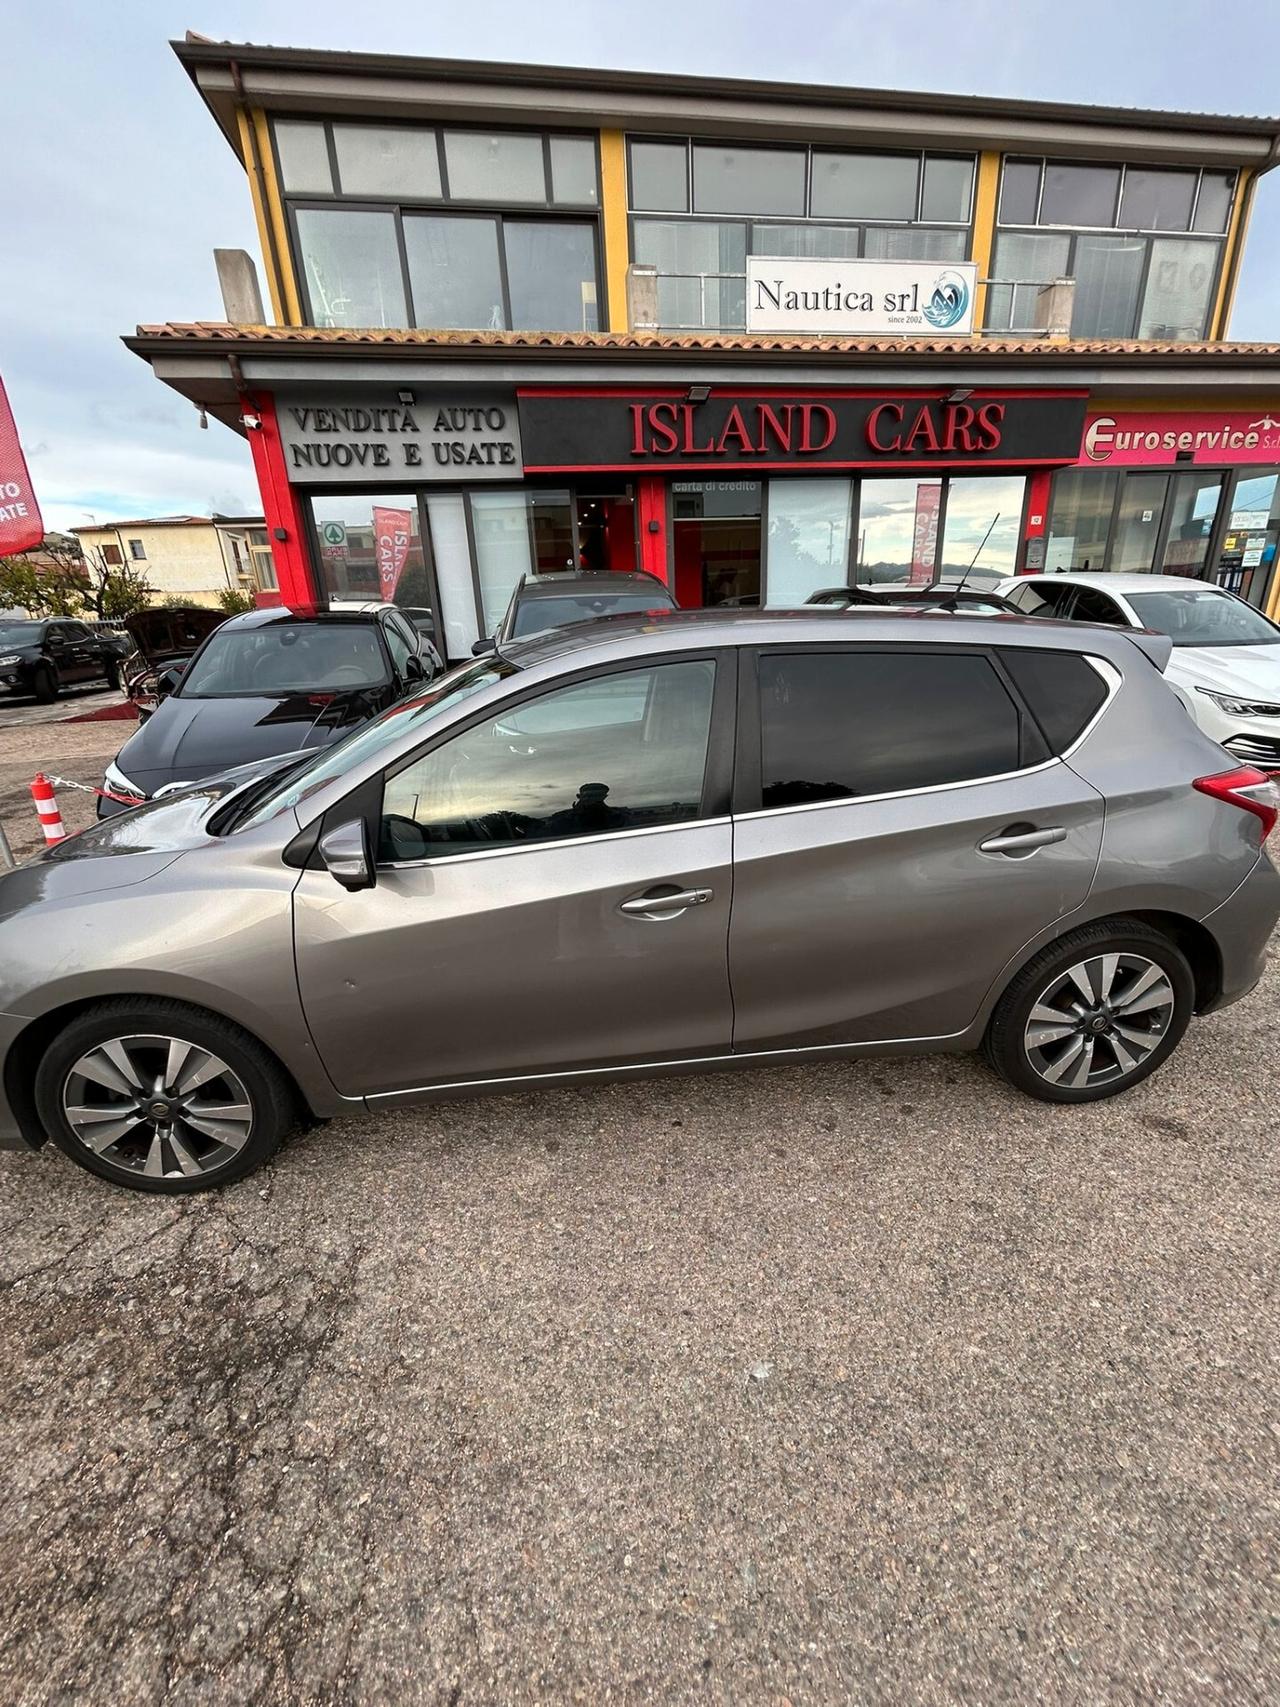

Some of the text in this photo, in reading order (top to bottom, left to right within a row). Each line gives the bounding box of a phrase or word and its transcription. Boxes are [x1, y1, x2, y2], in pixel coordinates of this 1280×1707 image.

[754, 280, 918, 312] Nautica srl
[888, 315, 923, 325] since 2002
[288, 407, 506, 432] VENDITA AUTO
[628, 403, 1007, 455] ISLAND CARS
[1085, 417, 1260, 461] Euroservice
[289, 442, 516, 467] NUOVE E USATE
[674, 480, 756, 491] carta di credito
[380, 535, 394, 583] CARS
